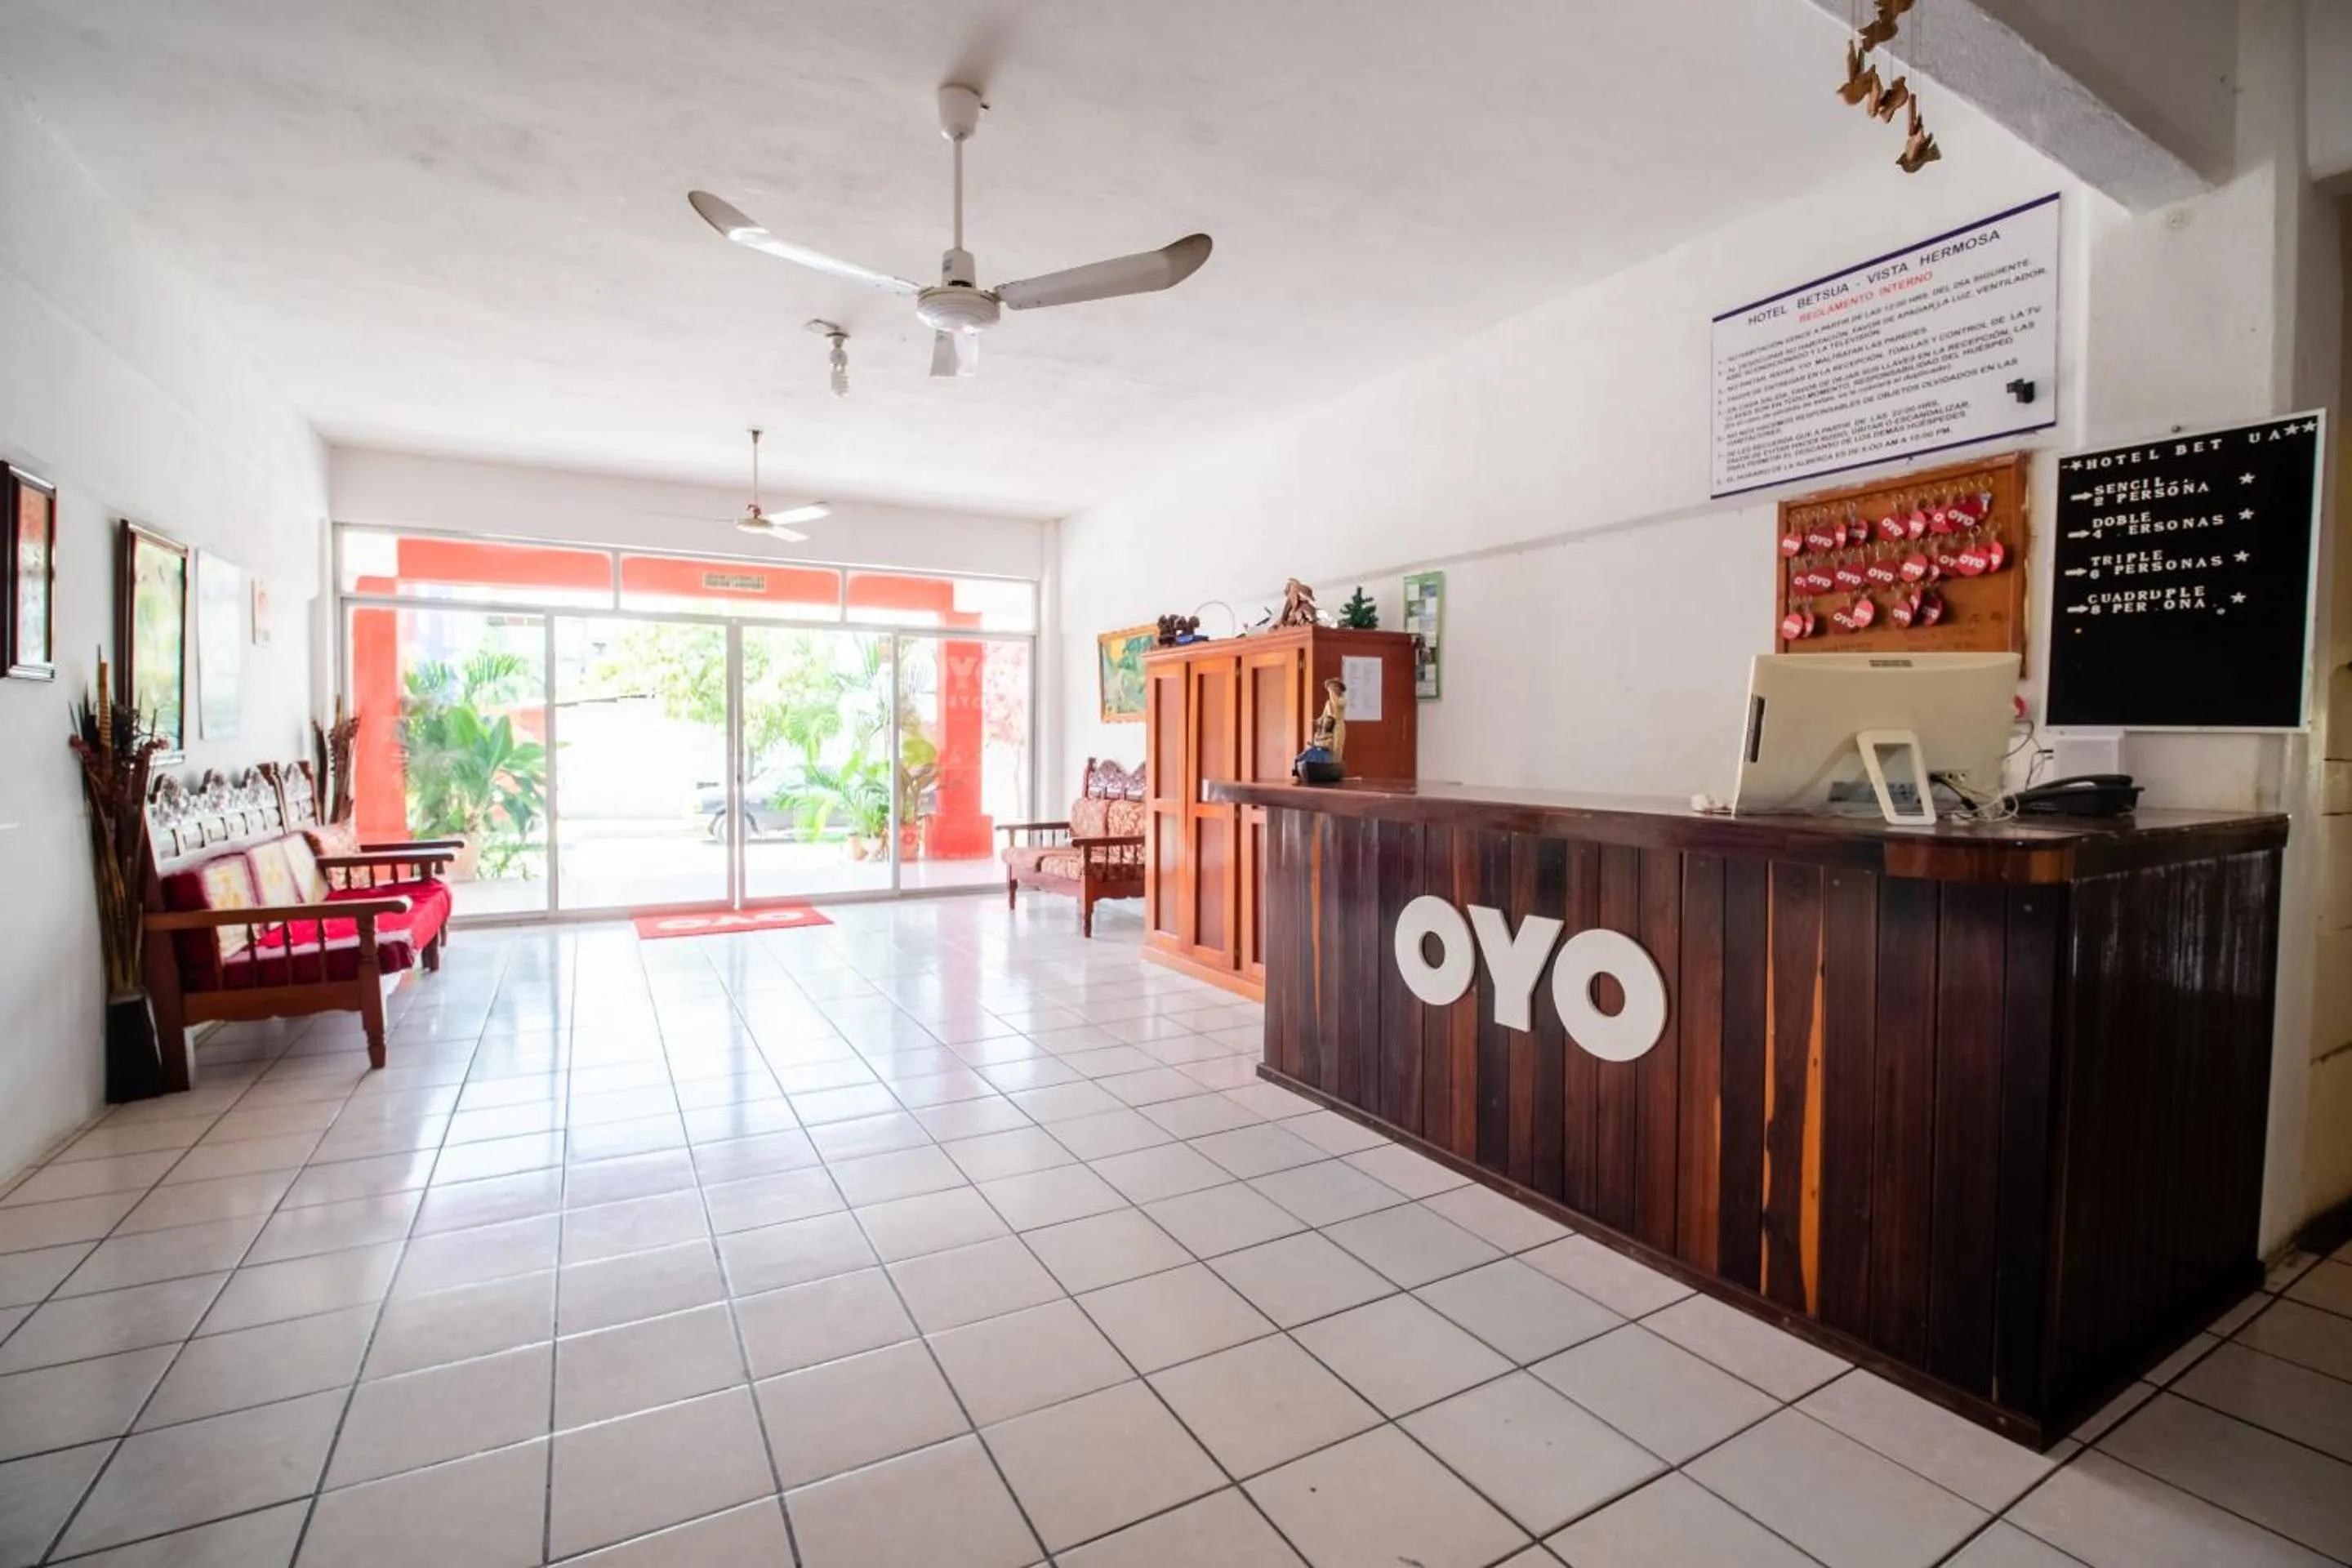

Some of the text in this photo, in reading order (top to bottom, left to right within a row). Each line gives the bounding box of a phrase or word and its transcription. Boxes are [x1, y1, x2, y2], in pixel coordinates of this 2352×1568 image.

[1748, 305, 1787, 324] HOTEL
[1797, 283, 1849, 309] BETSUA
[1867, 262, 1908, 284] VISTA
[1920, 230, 2000, 265] HERMOSA
[1799, 271, 1932, 322] REGLAMENTO INTERNO
[2086, 449, 2159, 470] HOTEL
[2117, 482, 2209, 504] PERSONA
[1948, 510, 1975, 527] OYO
[2092, 511, 2151, 528] DOBLE
[1809, 533, 1833, 548] OYO
[2091, 529, 2102, 539] 4
[1959, 554, 1986, 568] OYO
[2091, 550, 2163, 567] TRIPLE
[2114, 555, 2223, 575] PERSONAS
[1807, 574, 1832, 588] OYO
[1838, 571, 1862, 585] OYO
[1868, 568, 1894, 582] OYO
[2087, 586, 2205, 604] CUADRUPLE
[2091, 604, 2101, 615] 8
[1833, 612, 1856, 628] OYO
[1395, 895, 1668, 1062] OYO
